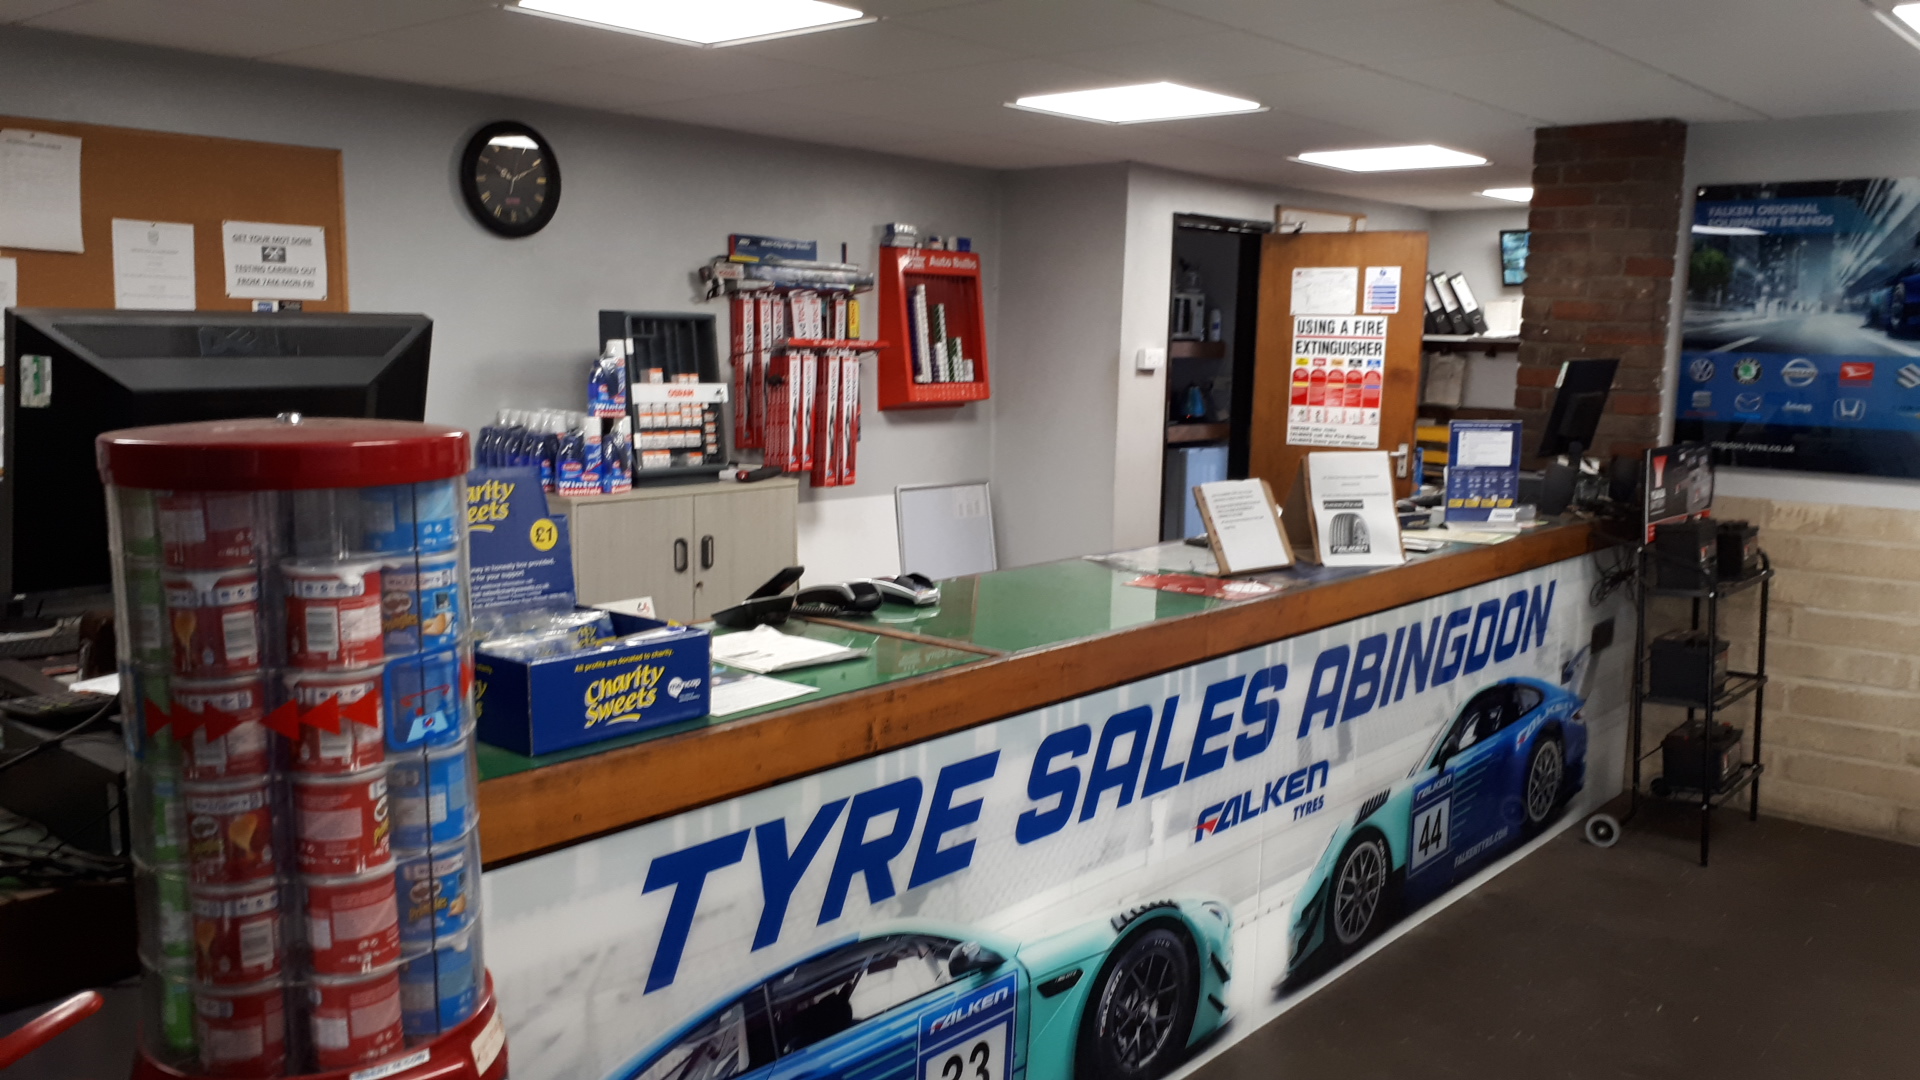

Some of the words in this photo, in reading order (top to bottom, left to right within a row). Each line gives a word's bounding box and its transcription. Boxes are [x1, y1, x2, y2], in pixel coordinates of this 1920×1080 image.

[1708, 206, 1755, 217] FALKEN
[1756, 203, 1820, 216] ORIGINAL
[1780, 214, 1835, 228] BRANDS
[232, 233, 247, 243] GET
[249, 234, 270, 244] YOUR
[272, 236, 289, 245] MOT
[291, 236, 313, 246] DONE
[235, 264, 265, 273] TESTING
[267, 266, 298, 274] CARRIED
[300, 267, 317, 275] OUT
[929, 255, 952, 268] Auto
[953, 256, 977, 270] Bulbs
[236, 277, 261, 286] FROM
[1297, 320, 1336, 335] USING
[1340, 320, 1349, 334] A
[1354, 320, 1384, 335] FIRE
[1295, 340, 1383, 356] EXTINGUISHER
[667, 388, 695, 398] OSRAM
[466, 479, 516, 504] arity
[559, 481, 601, 489] Winter
[467, 500, 511, 525] eets
[535, 526, 554, 543] £1
[574, 664, 585, 673] All
[585, 660, 606, 673] profits
[606, 658, 618, 668] are
[618, 653, 643, 665] donated
[643, 652, 651, 660] to
[584, 664, 666, 708] Charity
[583, 687, 659, 730] Sweets
[1515, 702, 1575, 753] FALKEN
[641, 749, 1001, 995] TYRE
[1015, 663, 1289, 846] SALES
[1297, 580, 1557, 740] ABINGDON
[1416, 773, 1453, 802] FALKEN
[1191, 759, 1330, 844] FALKEN
[1293, 794, 1325, 822] TYRES
[1418, 807, 1443, 857] 44
[929, 986, 1010, 1036] FALKEN
[1099, 969, 1123, 1038] FALKEN
[941, 1041, 991, 1080] 23
